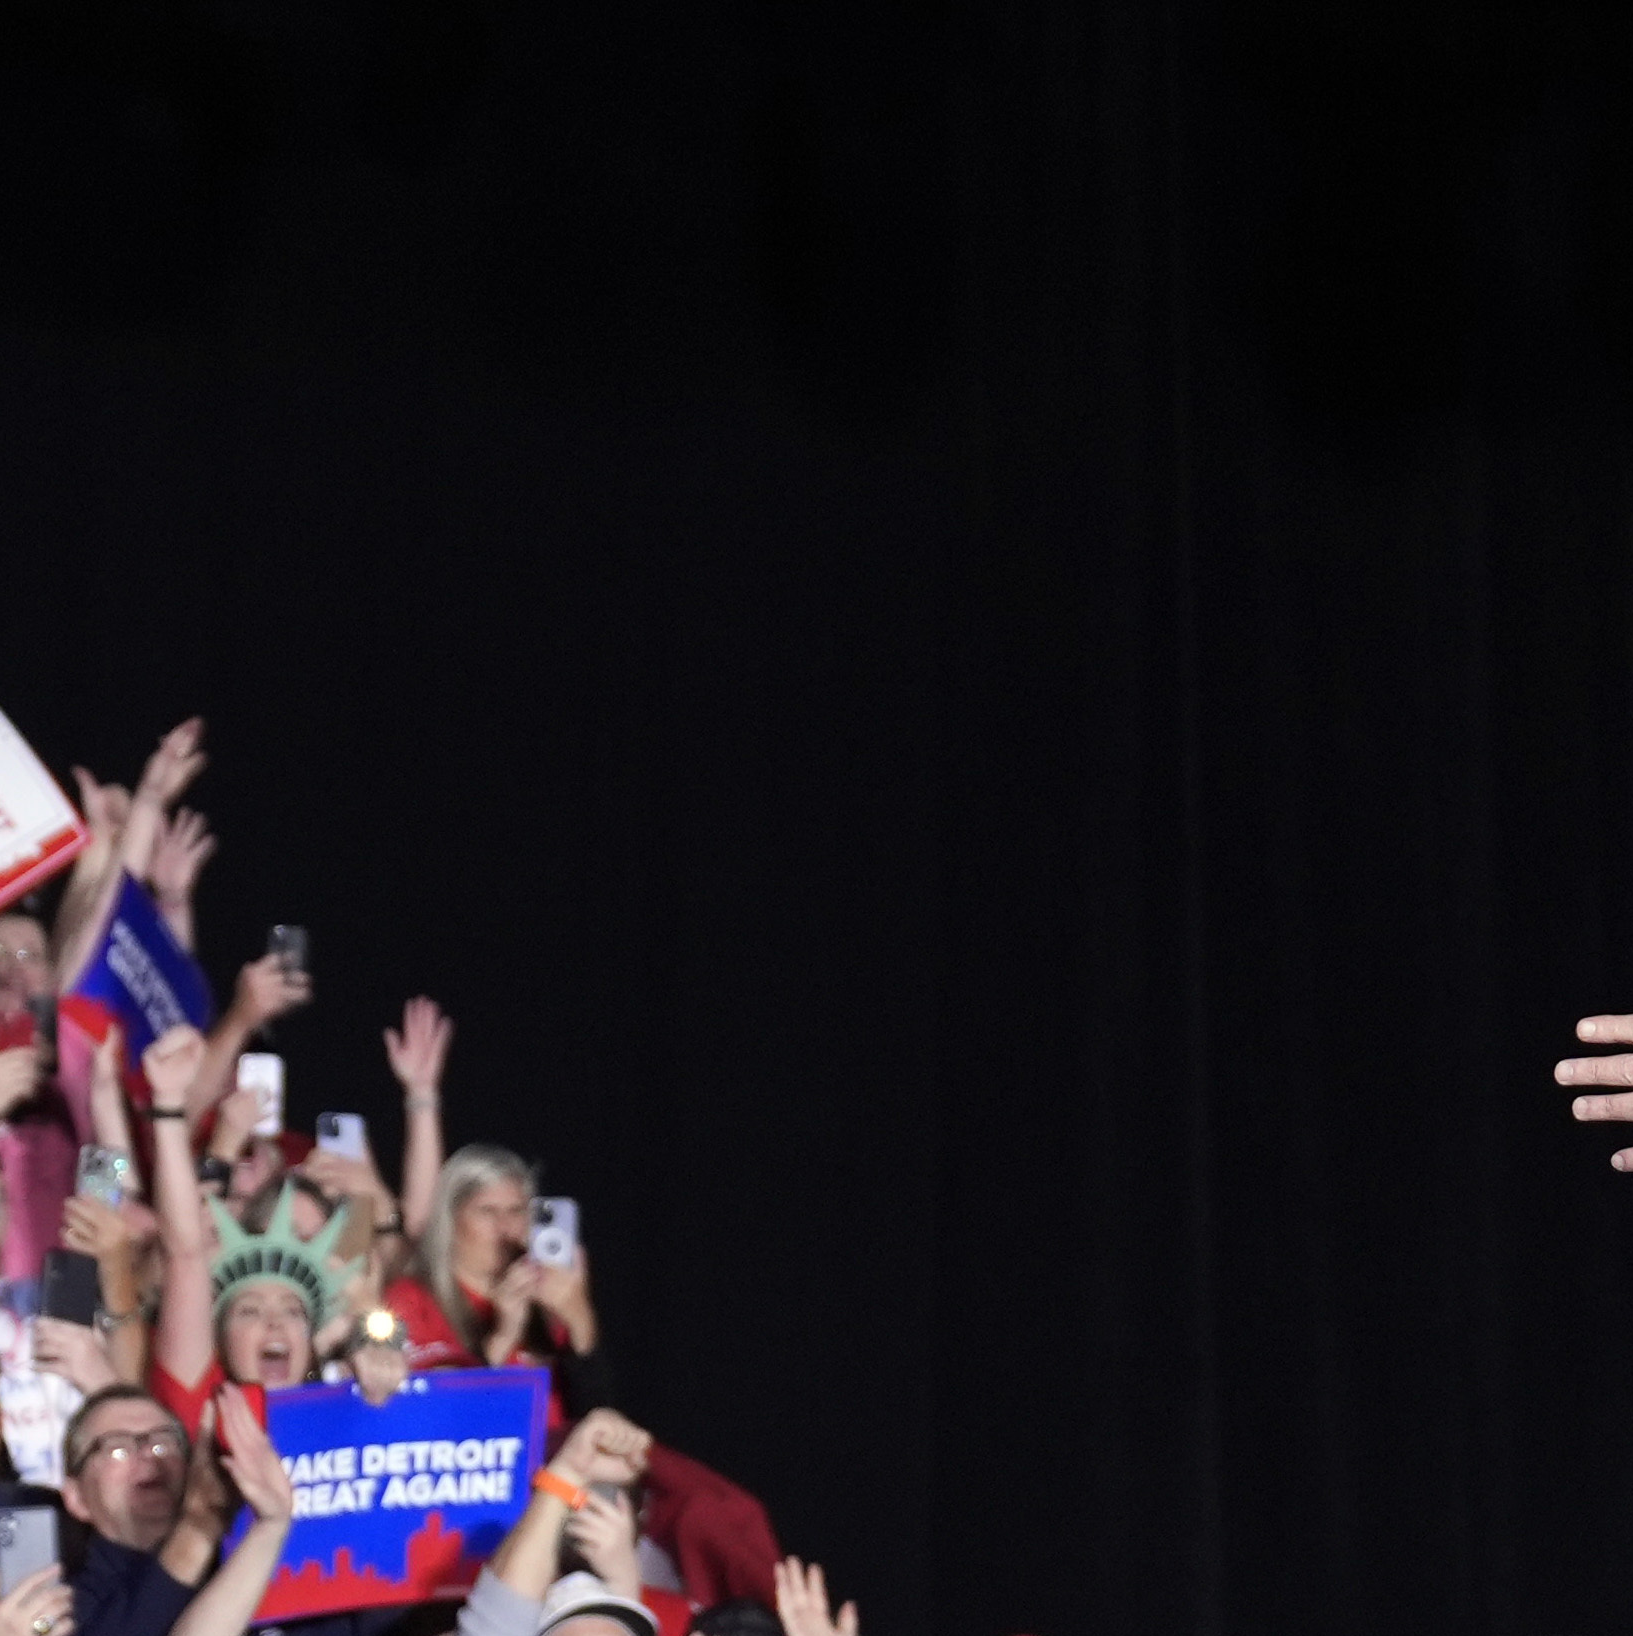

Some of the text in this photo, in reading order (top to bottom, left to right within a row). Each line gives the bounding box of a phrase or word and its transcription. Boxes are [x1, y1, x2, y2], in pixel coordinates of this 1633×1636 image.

[362, 1437, 522, 1477] DETROIT
[290, 1469, 513, 1519] REAT AGAIN!
